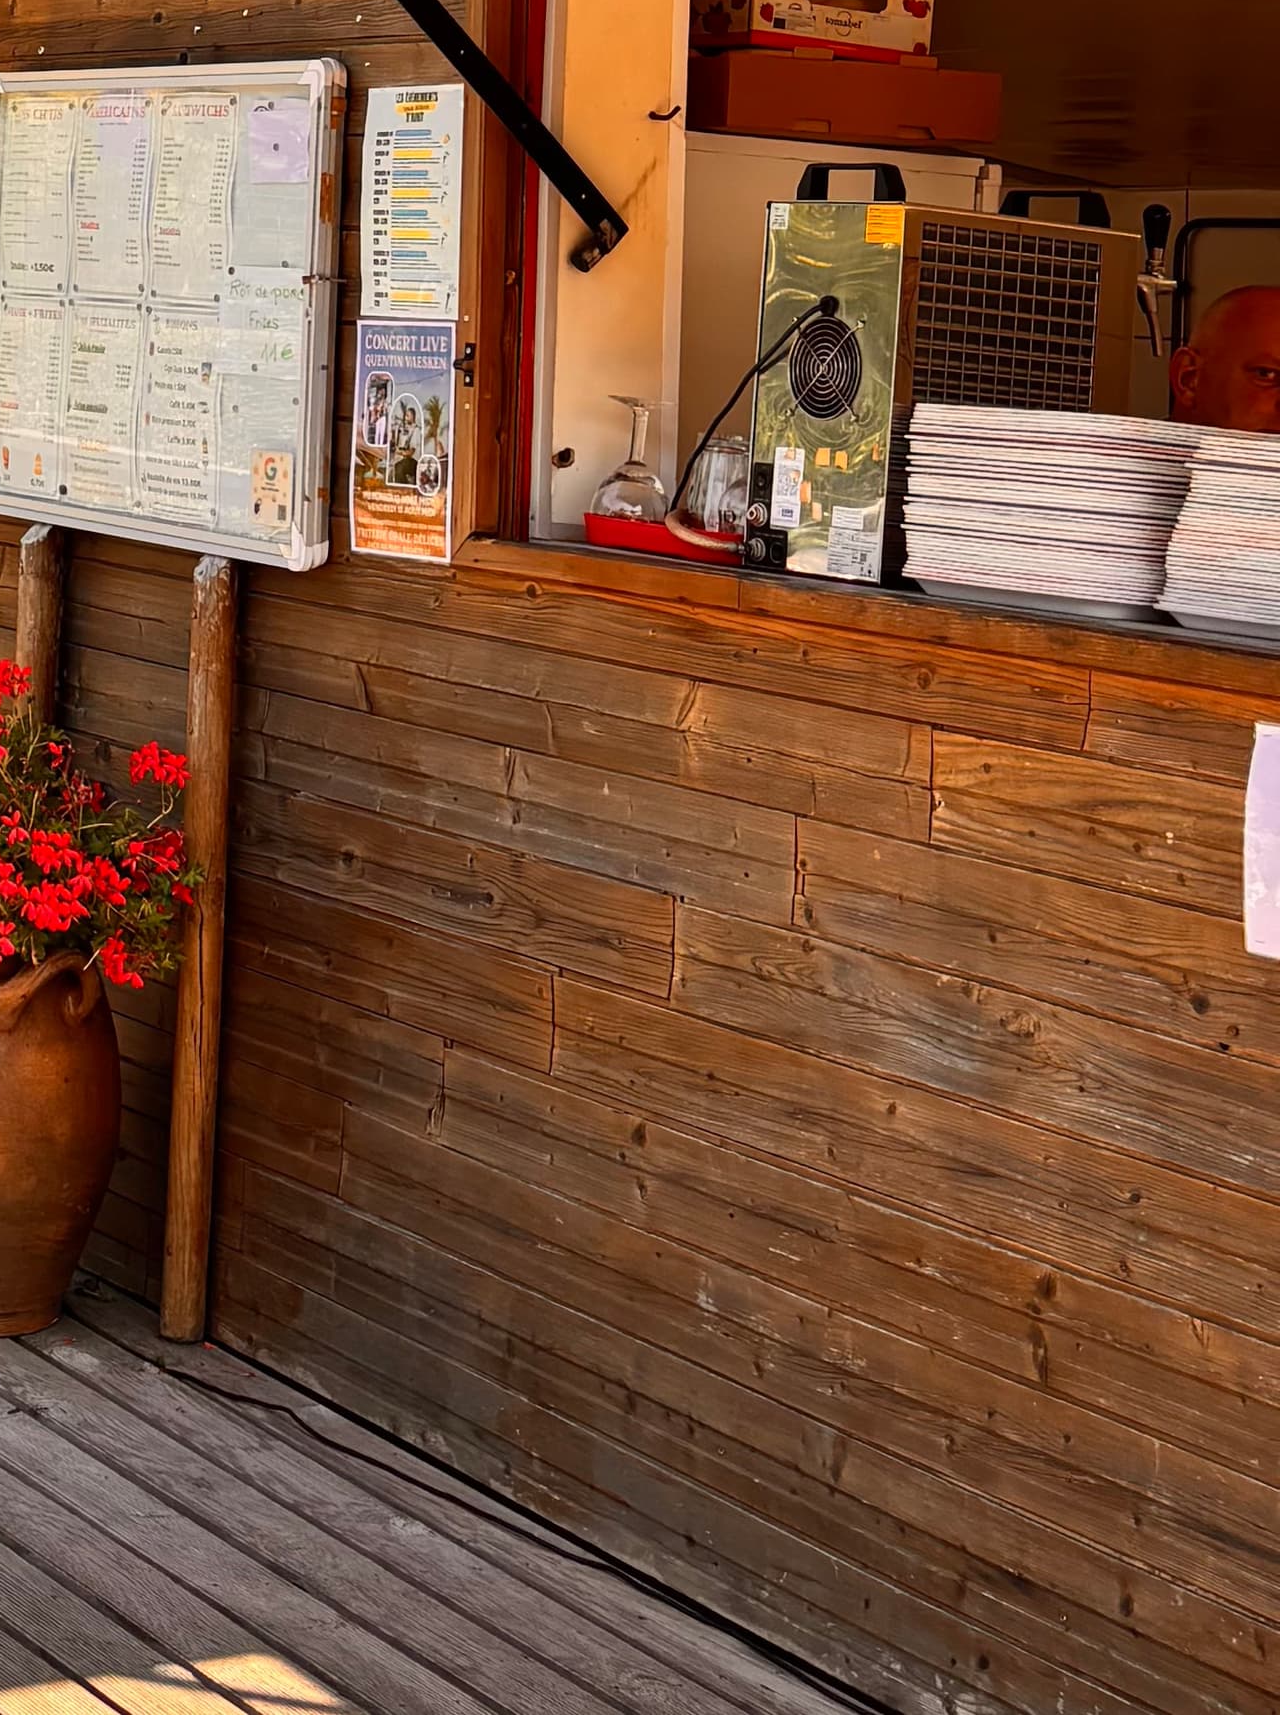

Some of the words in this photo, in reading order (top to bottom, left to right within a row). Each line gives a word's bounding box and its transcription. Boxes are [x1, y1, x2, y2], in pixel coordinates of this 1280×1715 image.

[365, 333, 418, 352] CONCERT
[420, 335, 449, 353] LIVE
[365, 354, 403, 368] QUENTIN
